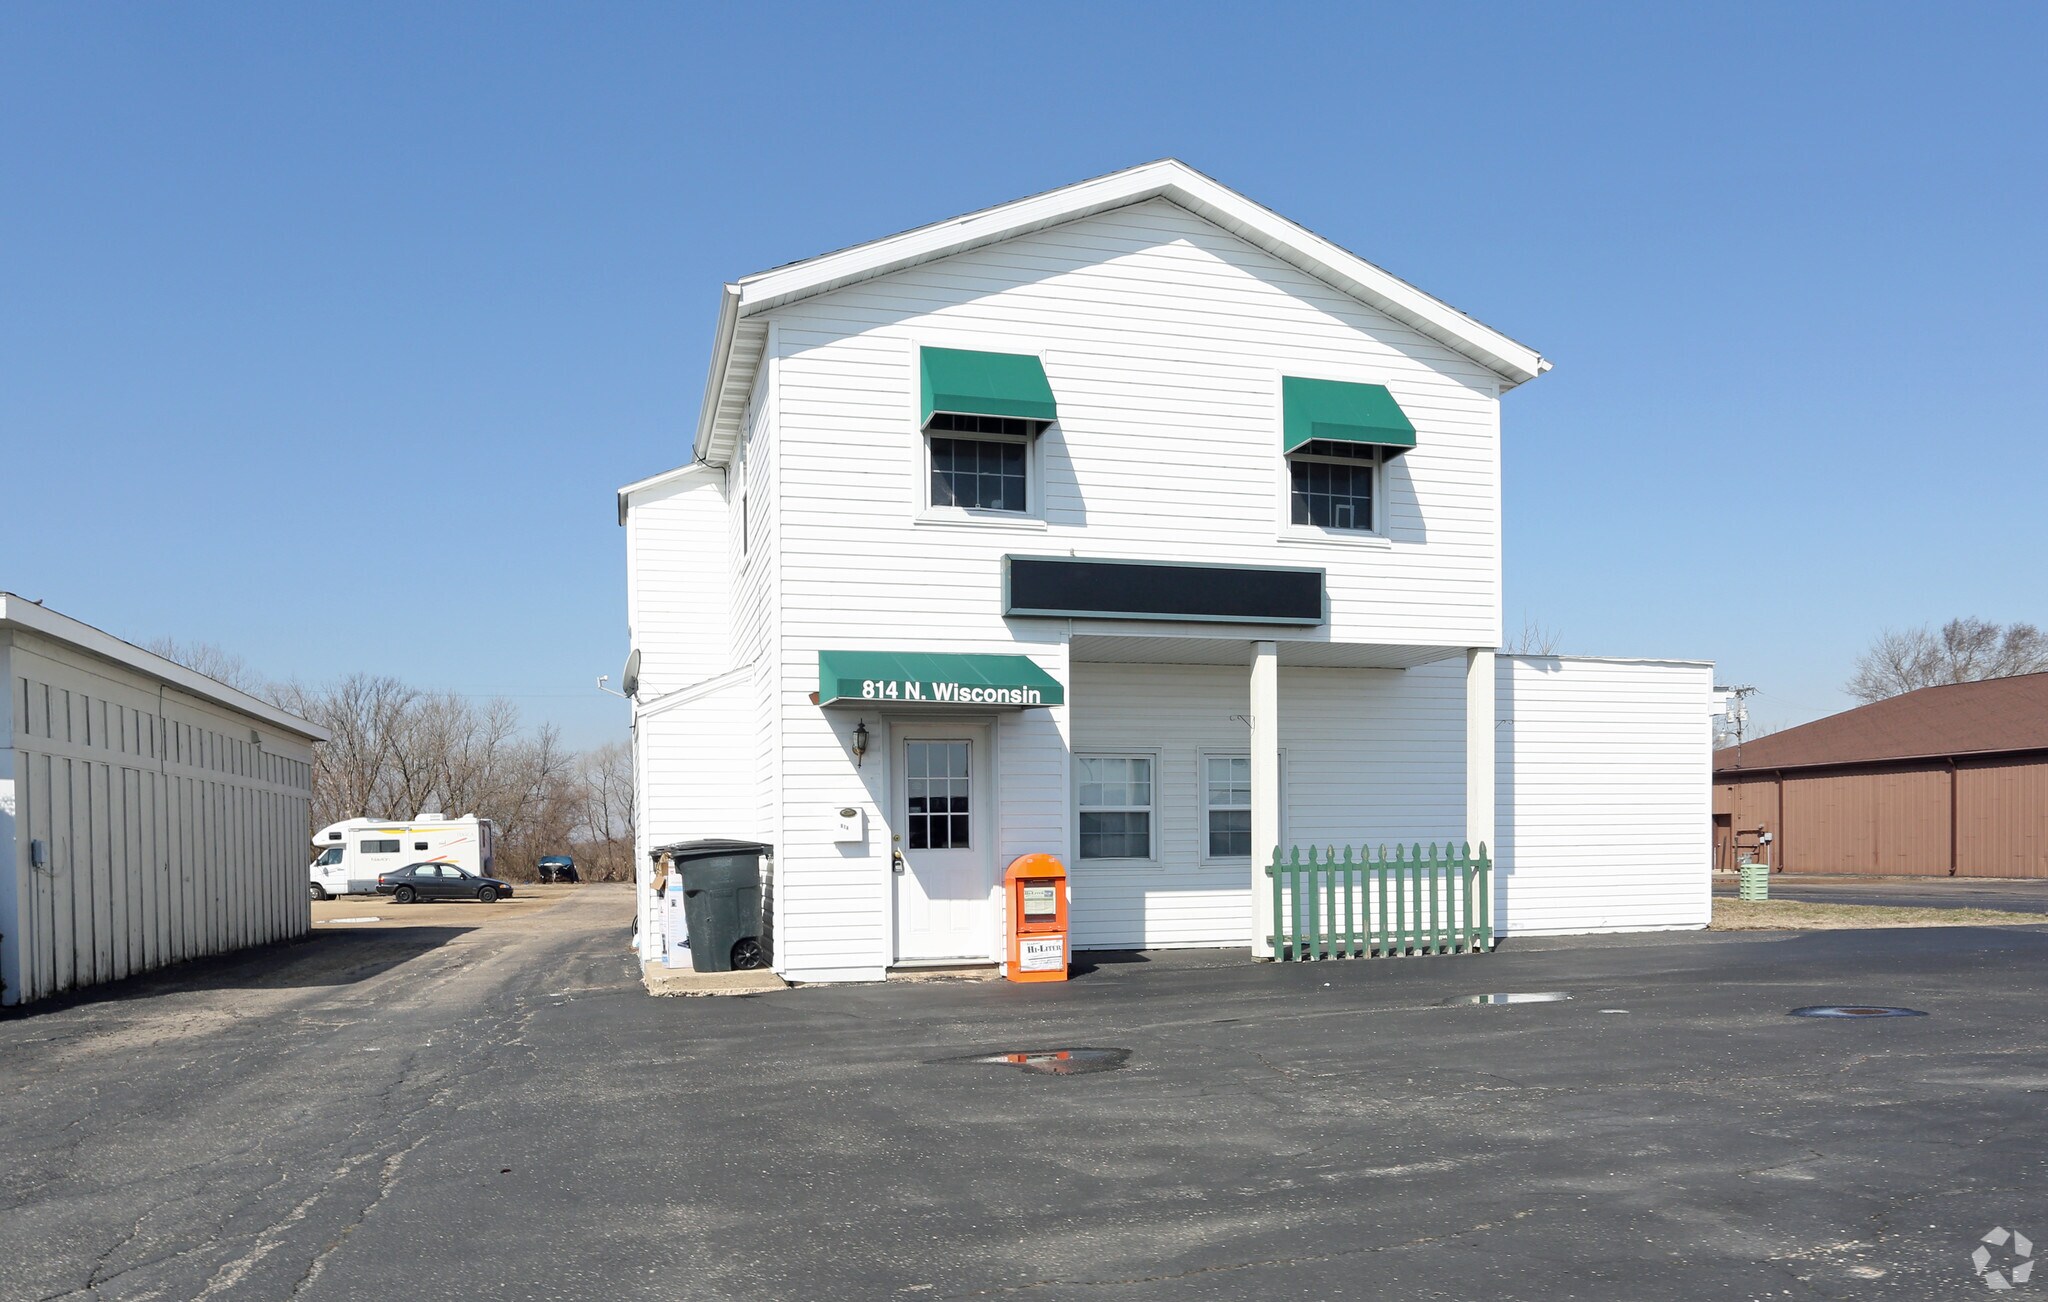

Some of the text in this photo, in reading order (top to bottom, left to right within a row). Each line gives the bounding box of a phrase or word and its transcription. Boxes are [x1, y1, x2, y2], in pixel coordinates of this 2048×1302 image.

[862, 680, 1041, 704] 814 N. Wisconsin
